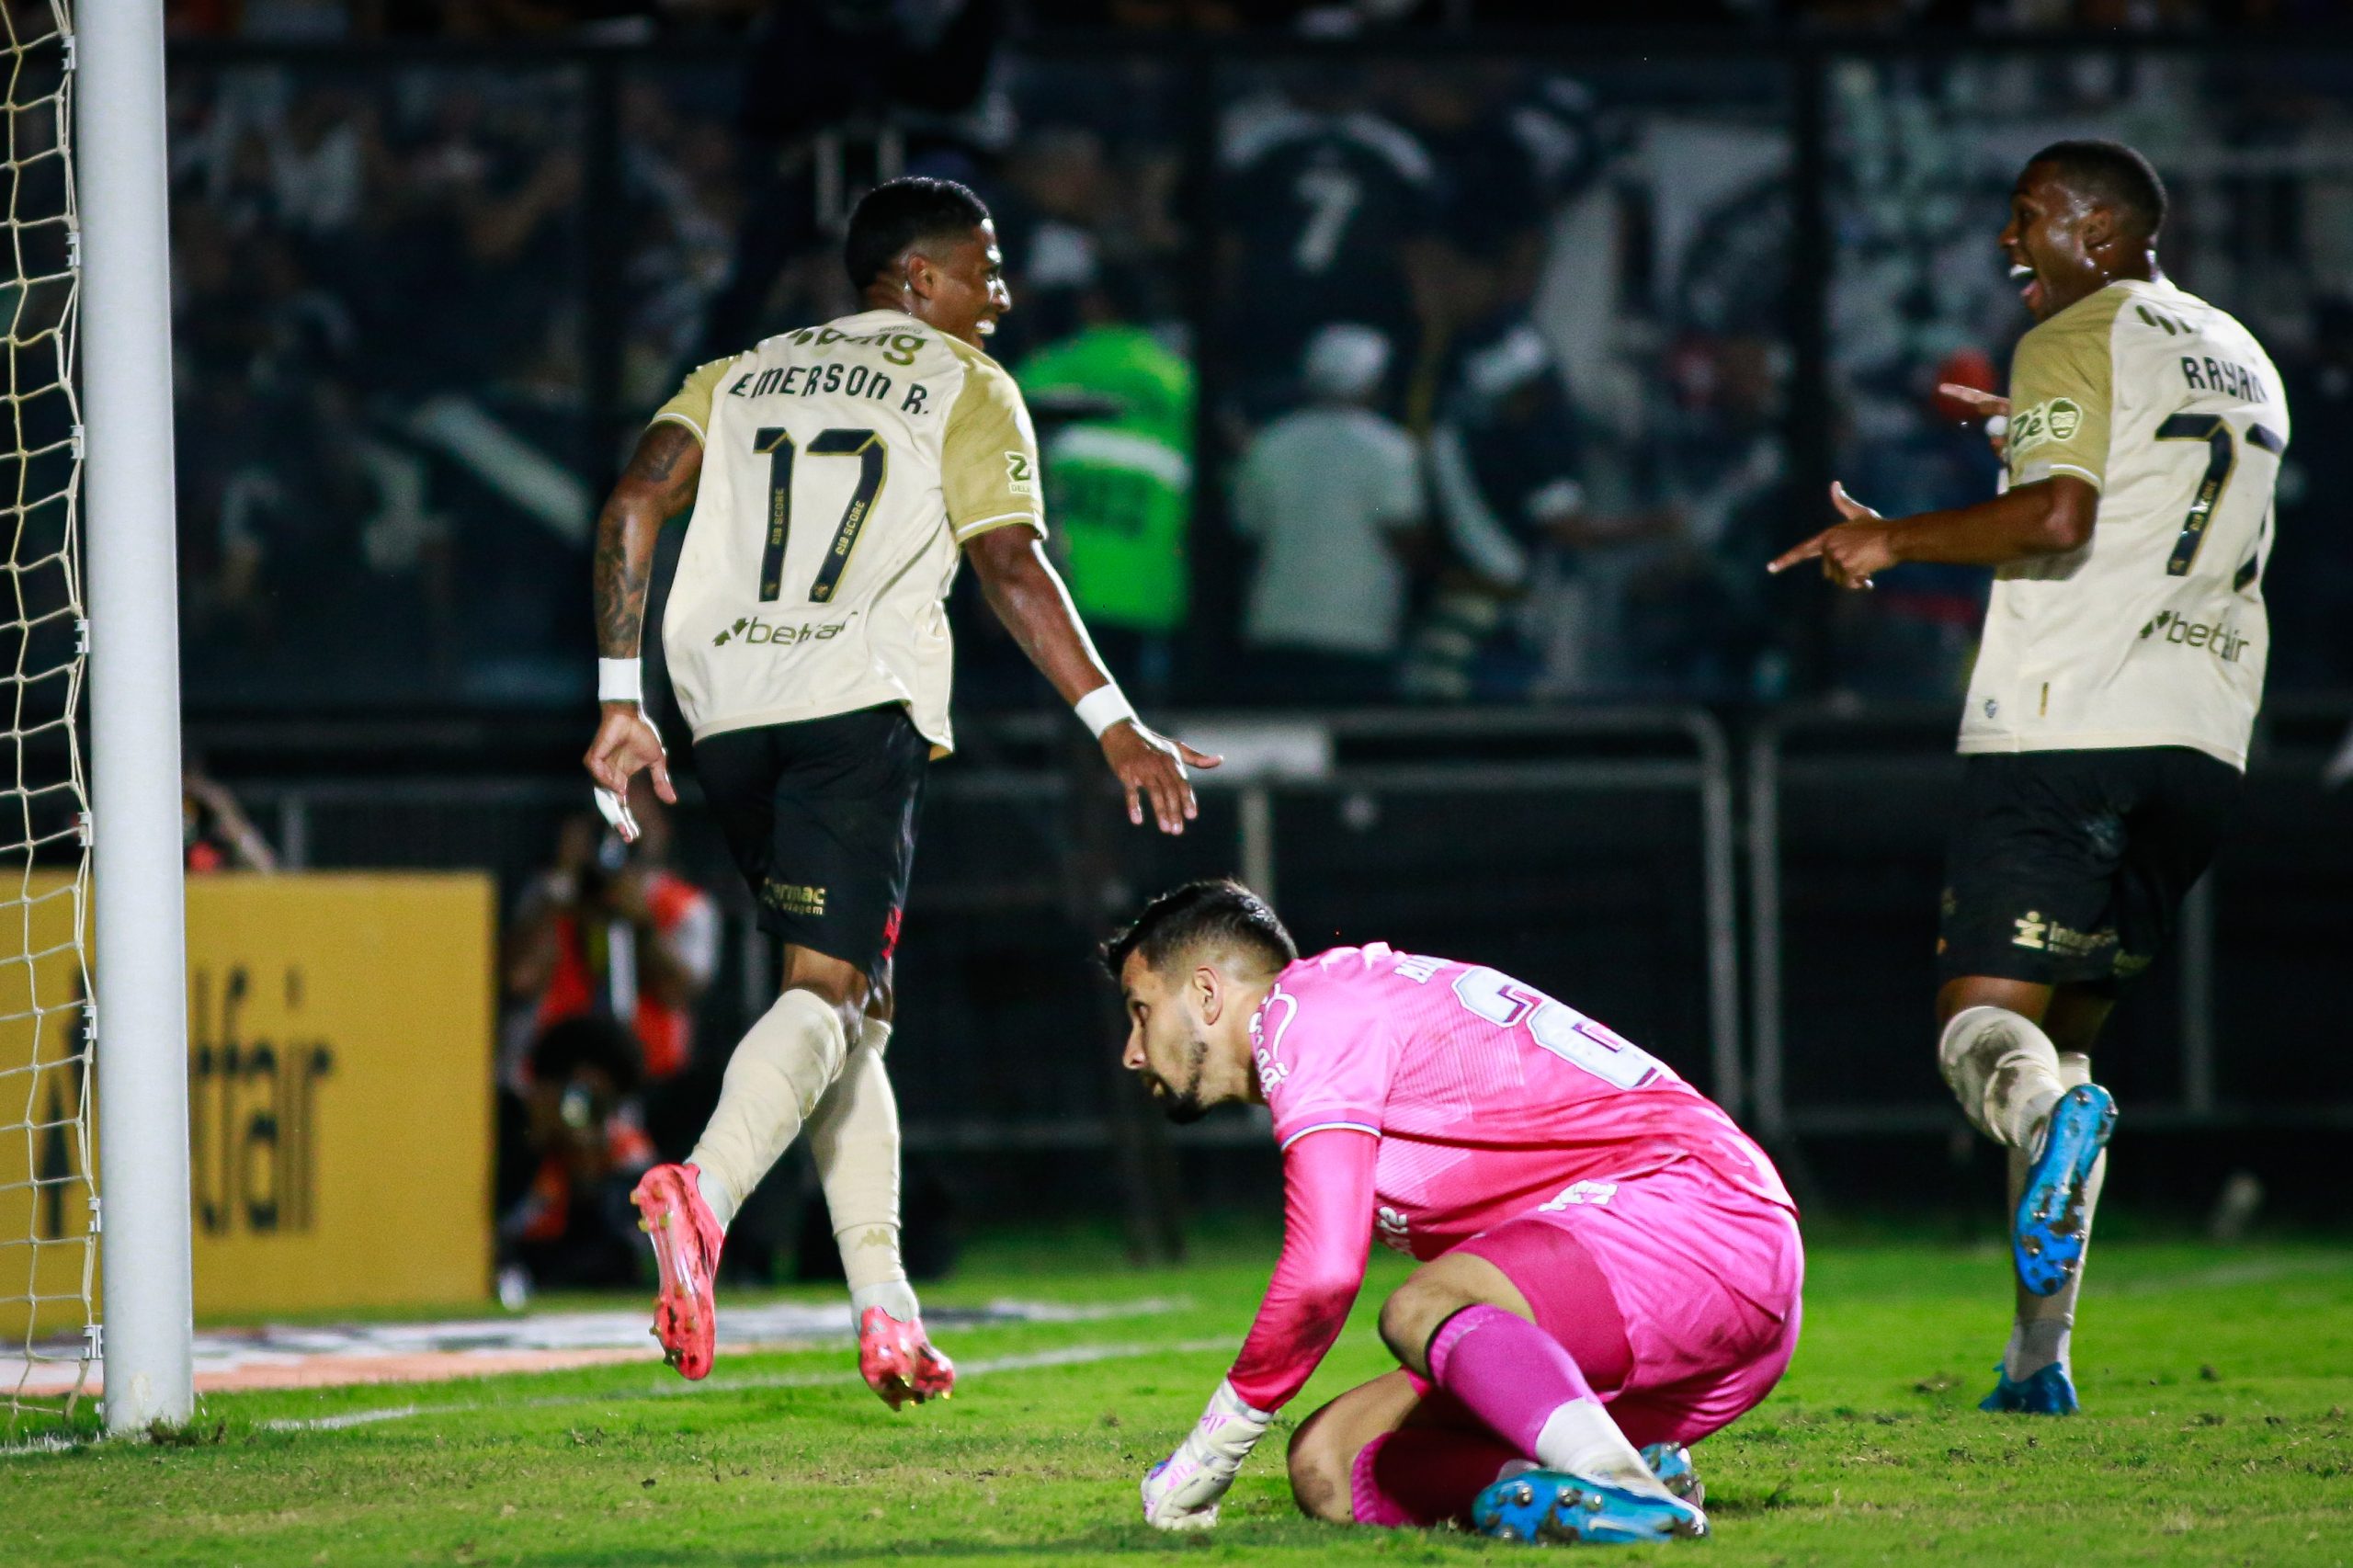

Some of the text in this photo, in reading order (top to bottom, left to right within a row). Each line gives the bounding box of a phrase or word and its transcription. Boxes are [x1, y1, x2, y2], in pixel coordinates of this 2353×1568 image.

[728, 363, 929, 415] EMERSON R.
[753, 426, 889, 603] 17
[843, 500, 865, 535] SCORE
